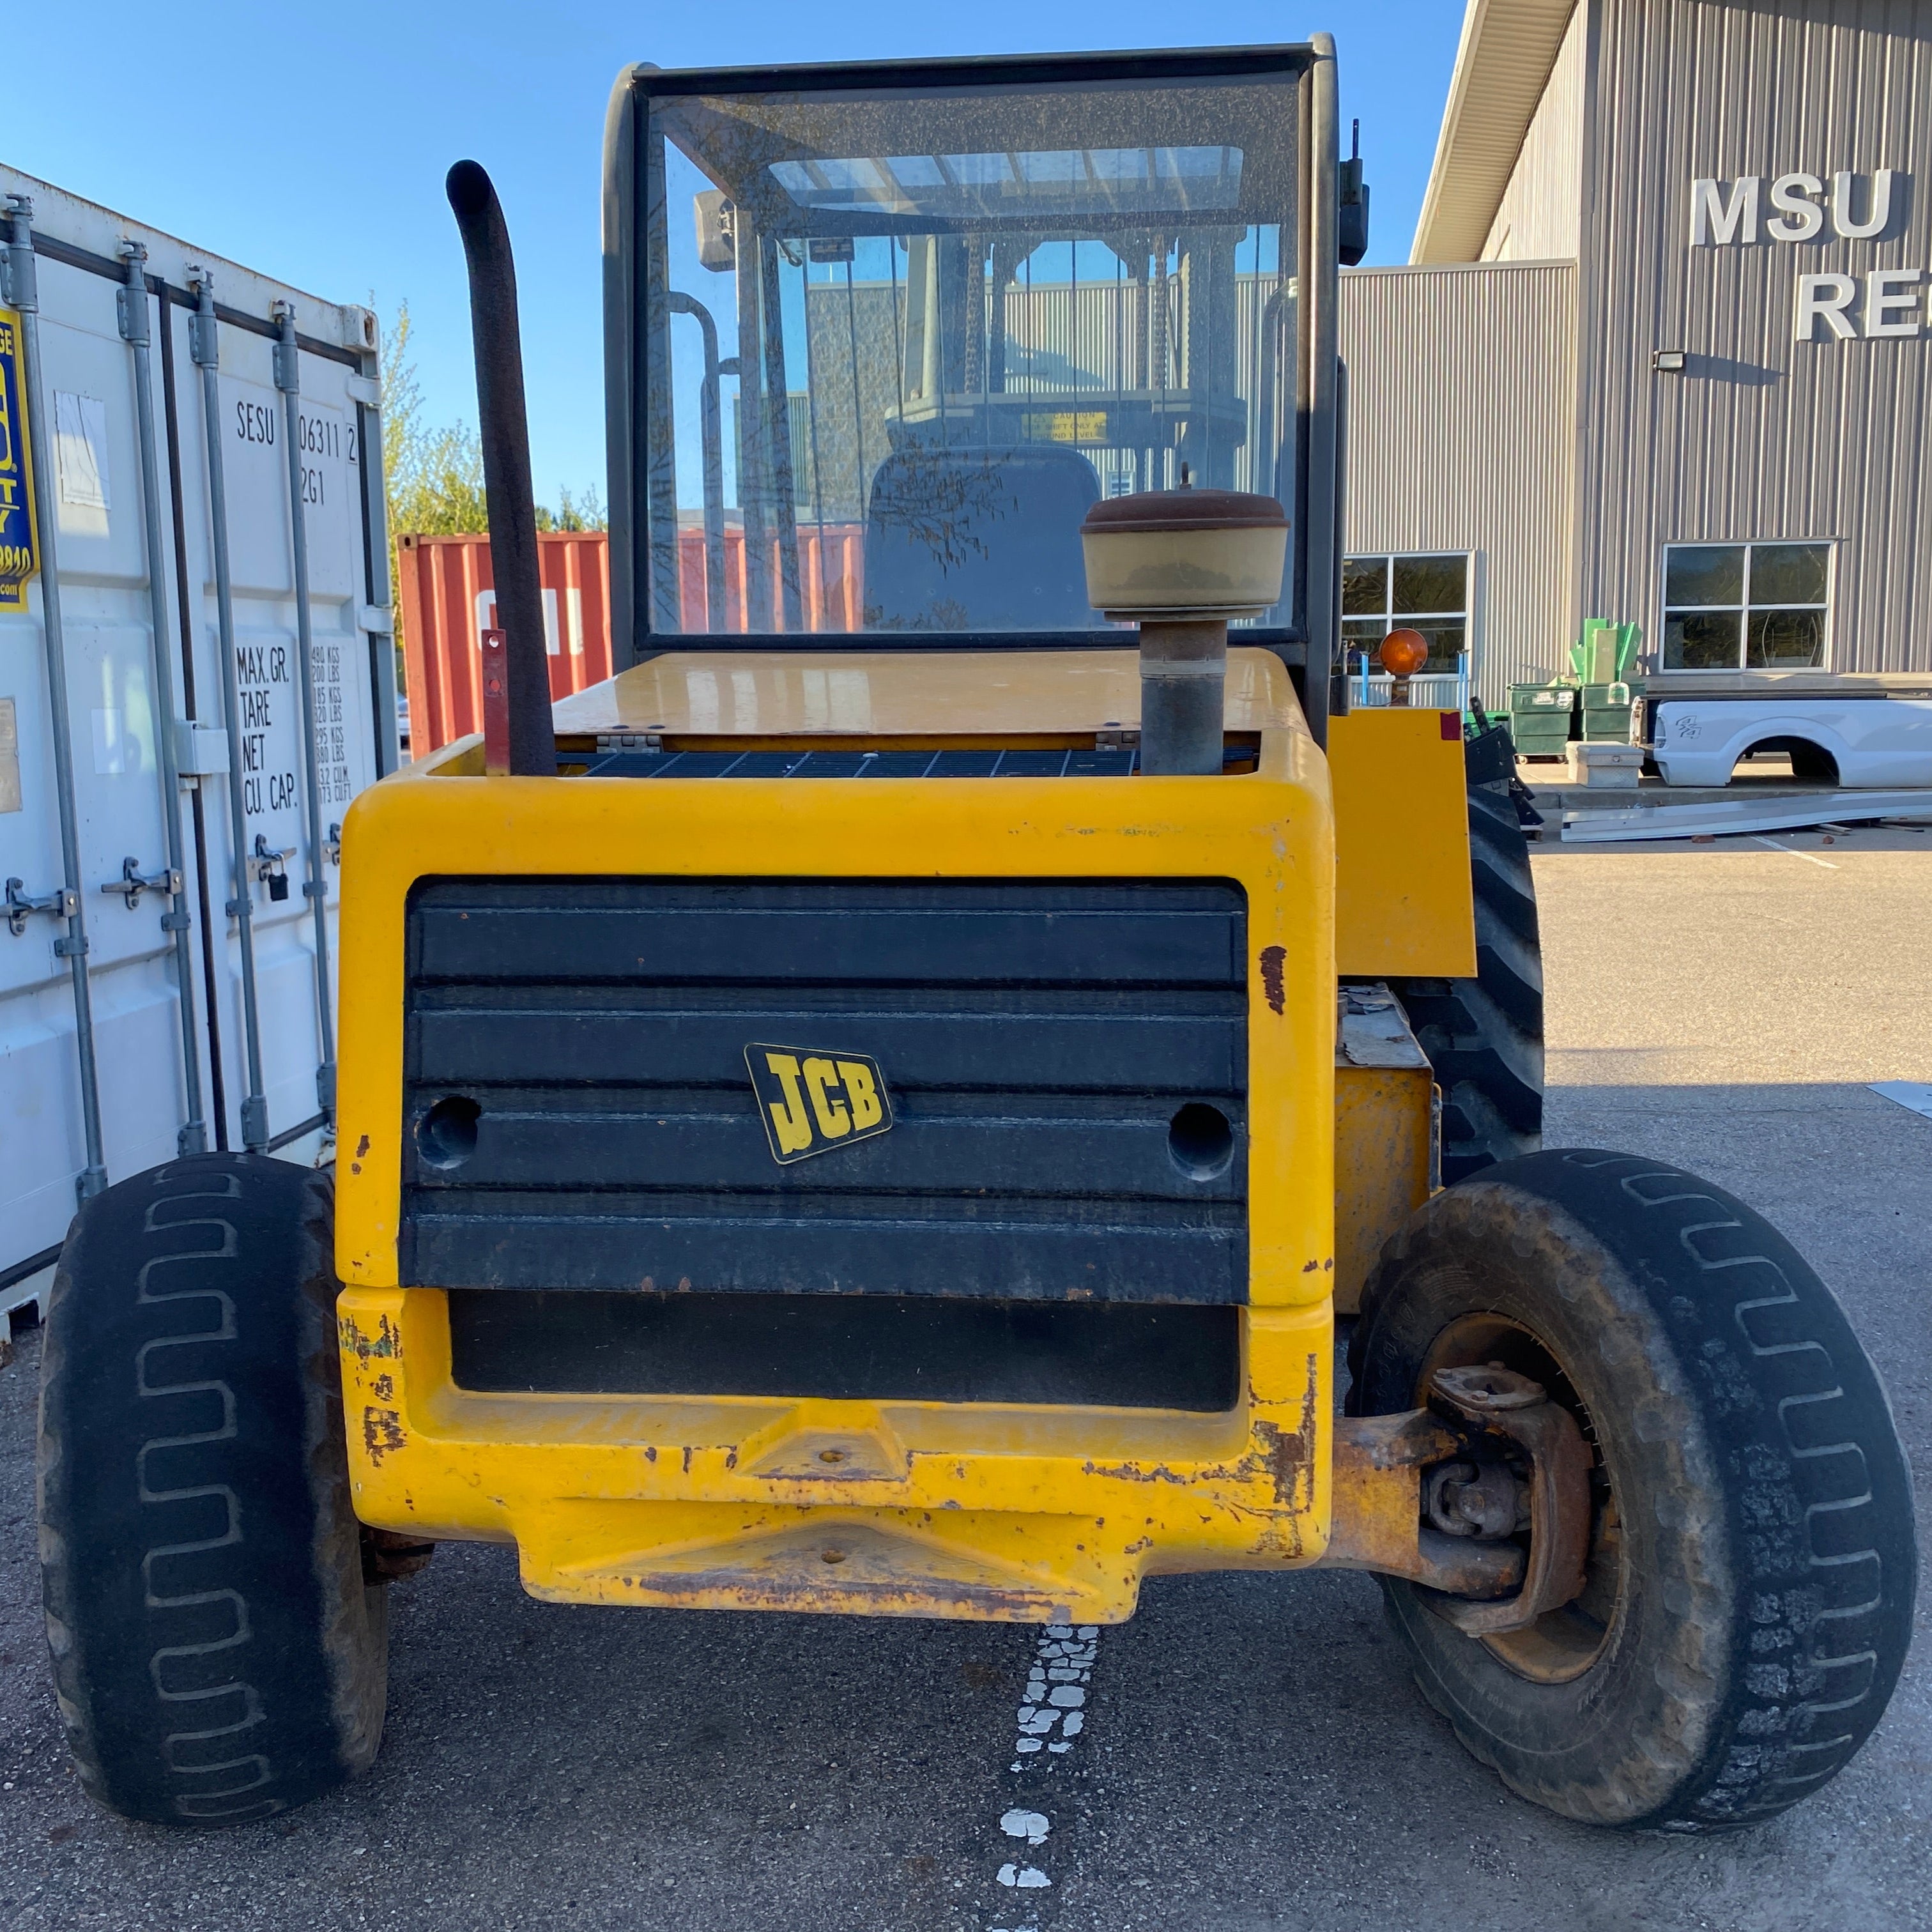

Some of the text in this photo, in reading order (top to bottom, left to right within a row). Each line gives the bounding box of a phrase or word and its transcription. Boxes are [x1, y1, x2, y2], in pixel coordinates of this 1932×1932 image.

[1690, 169, 1892, 246] MSU
[1797, 268, 1932, 341] RE
[237, 401, 273, 445] SESU
[299, 415, 339, 458] 06311
[240, 690, 272, 728] TARE
[243, 733, 264, 772] NET
[270, 772, 297, 810] CAP.
[765, 1052, 883, 1156] JCB
